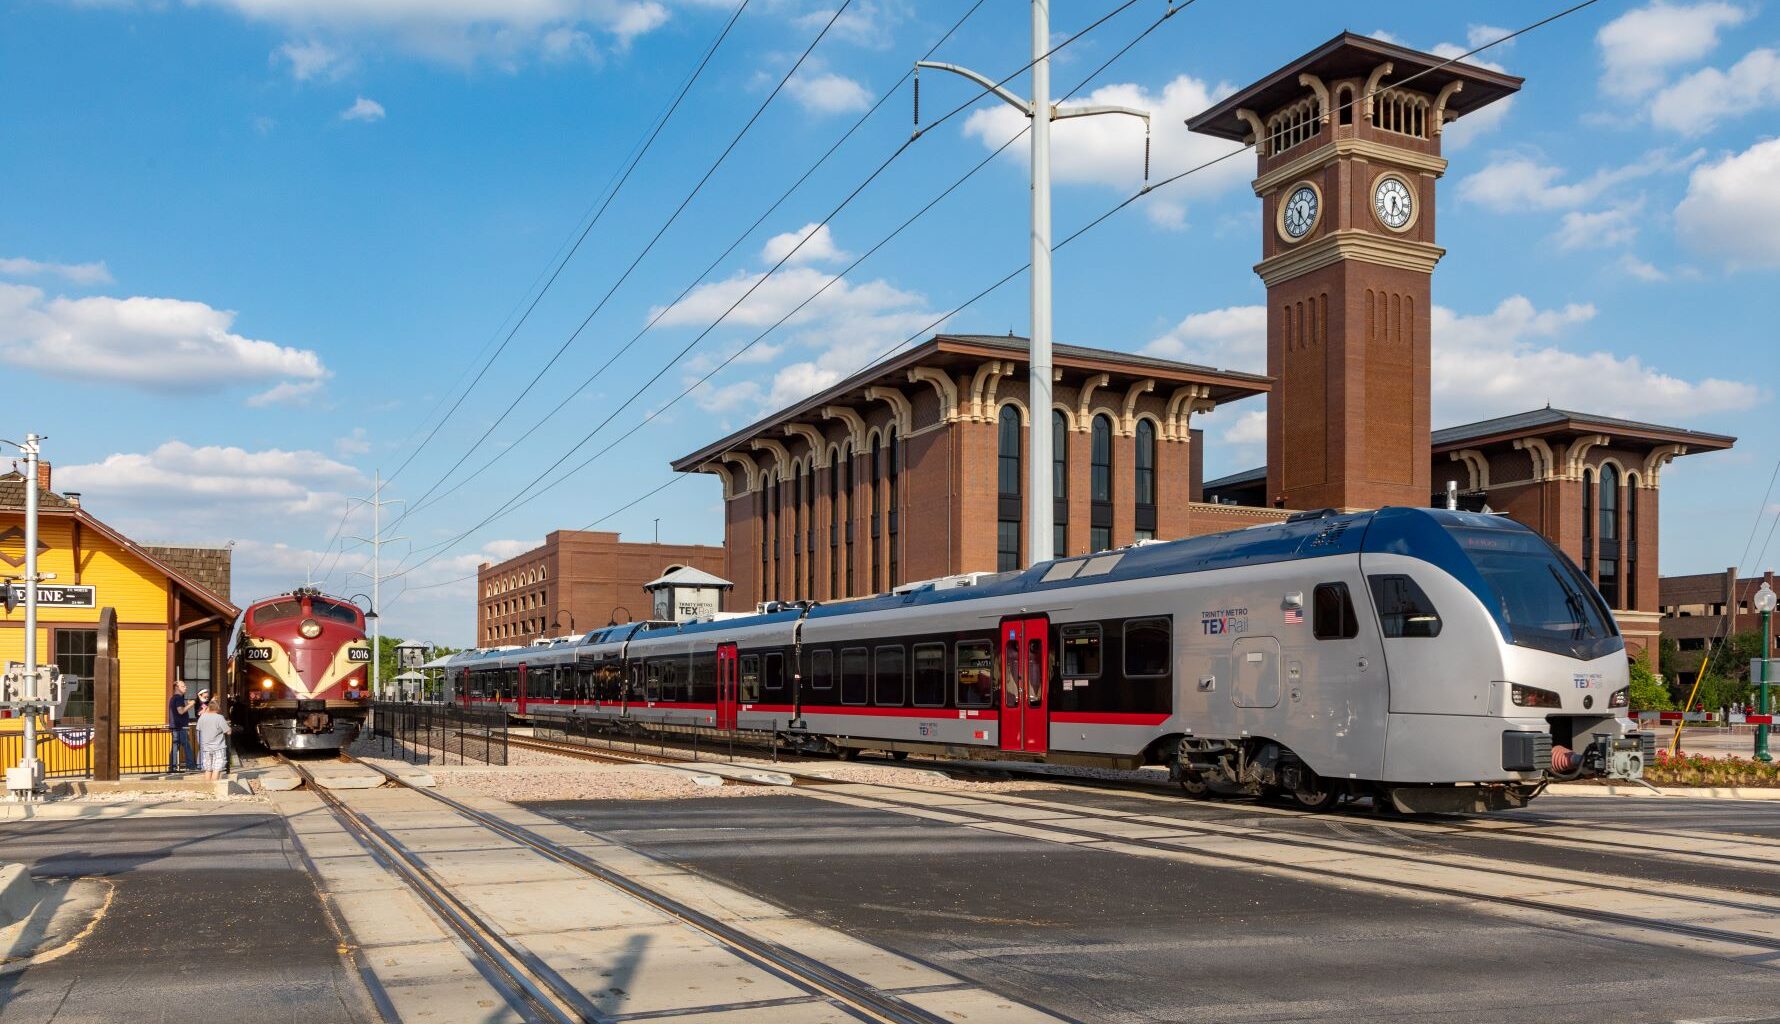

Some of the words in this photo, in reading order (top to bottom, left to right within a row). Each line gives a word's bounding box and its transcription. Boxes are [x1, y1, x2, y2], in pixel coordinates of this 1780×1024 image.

[1201, 610, 1225, 618] TRINITY
[1225, 608, 1249, 617] METRO
[248, 649, 269, 659] 2016
[351, 649, 369, 659] 2016
